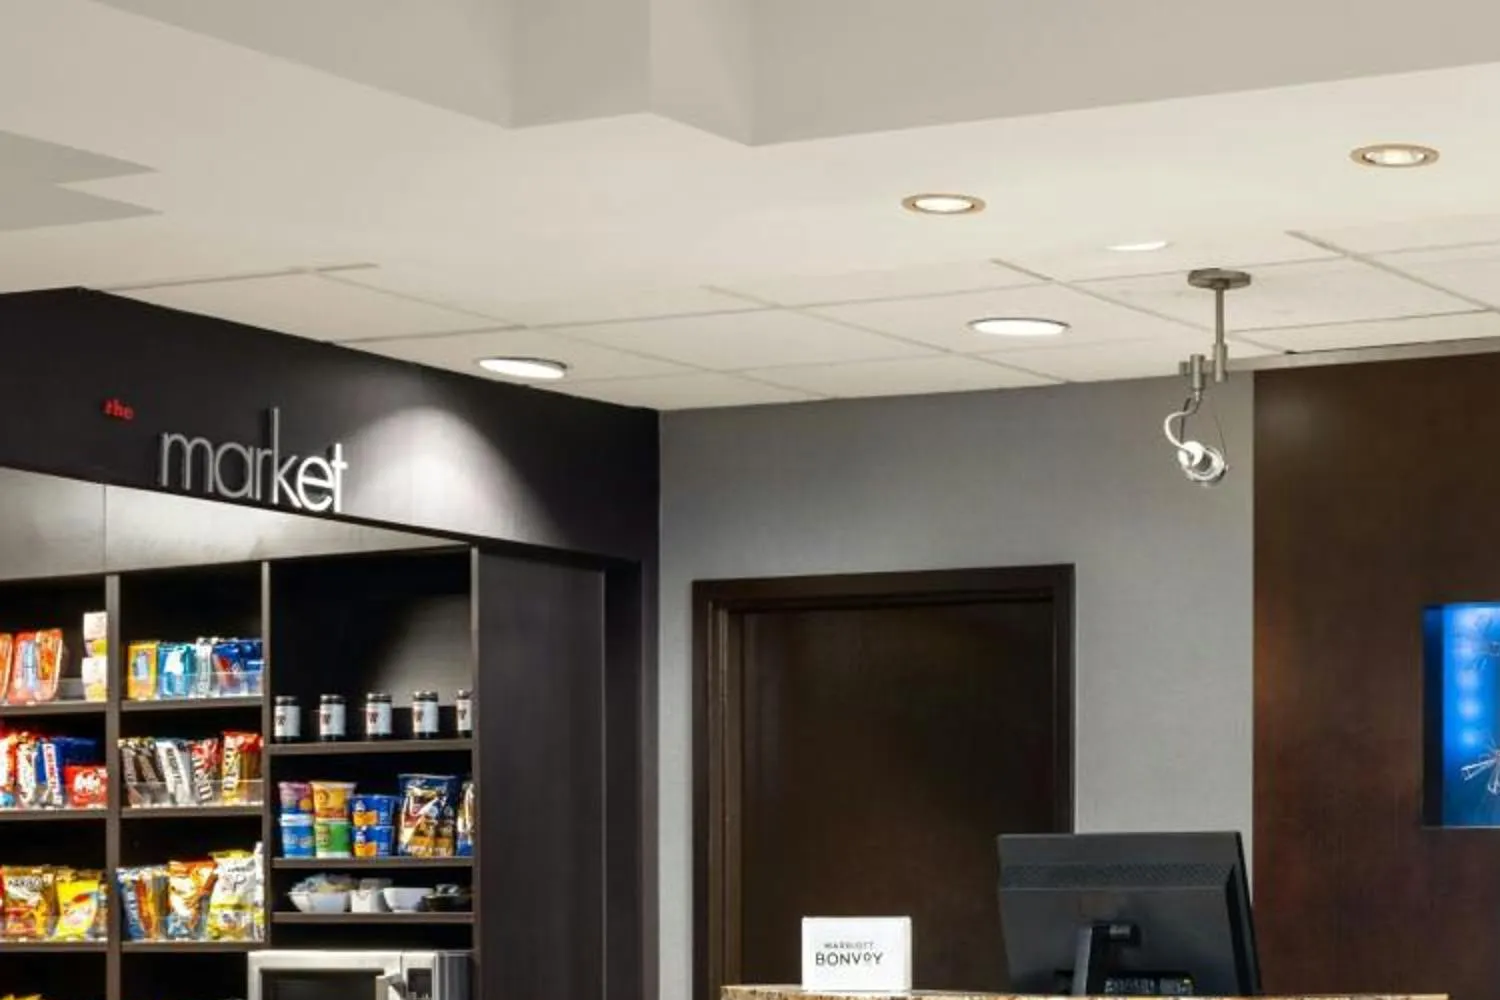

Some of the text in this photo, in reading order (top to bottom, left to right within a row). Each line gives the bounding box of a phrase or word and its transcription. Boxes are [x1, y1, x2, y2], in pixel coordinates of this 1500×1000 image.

[105, 399, 134, 420] the
[161, 407, 348, 513] market
[824, 941, 874, 949] MARRIOTT
[815, 952, 883, 966] BONVOY
